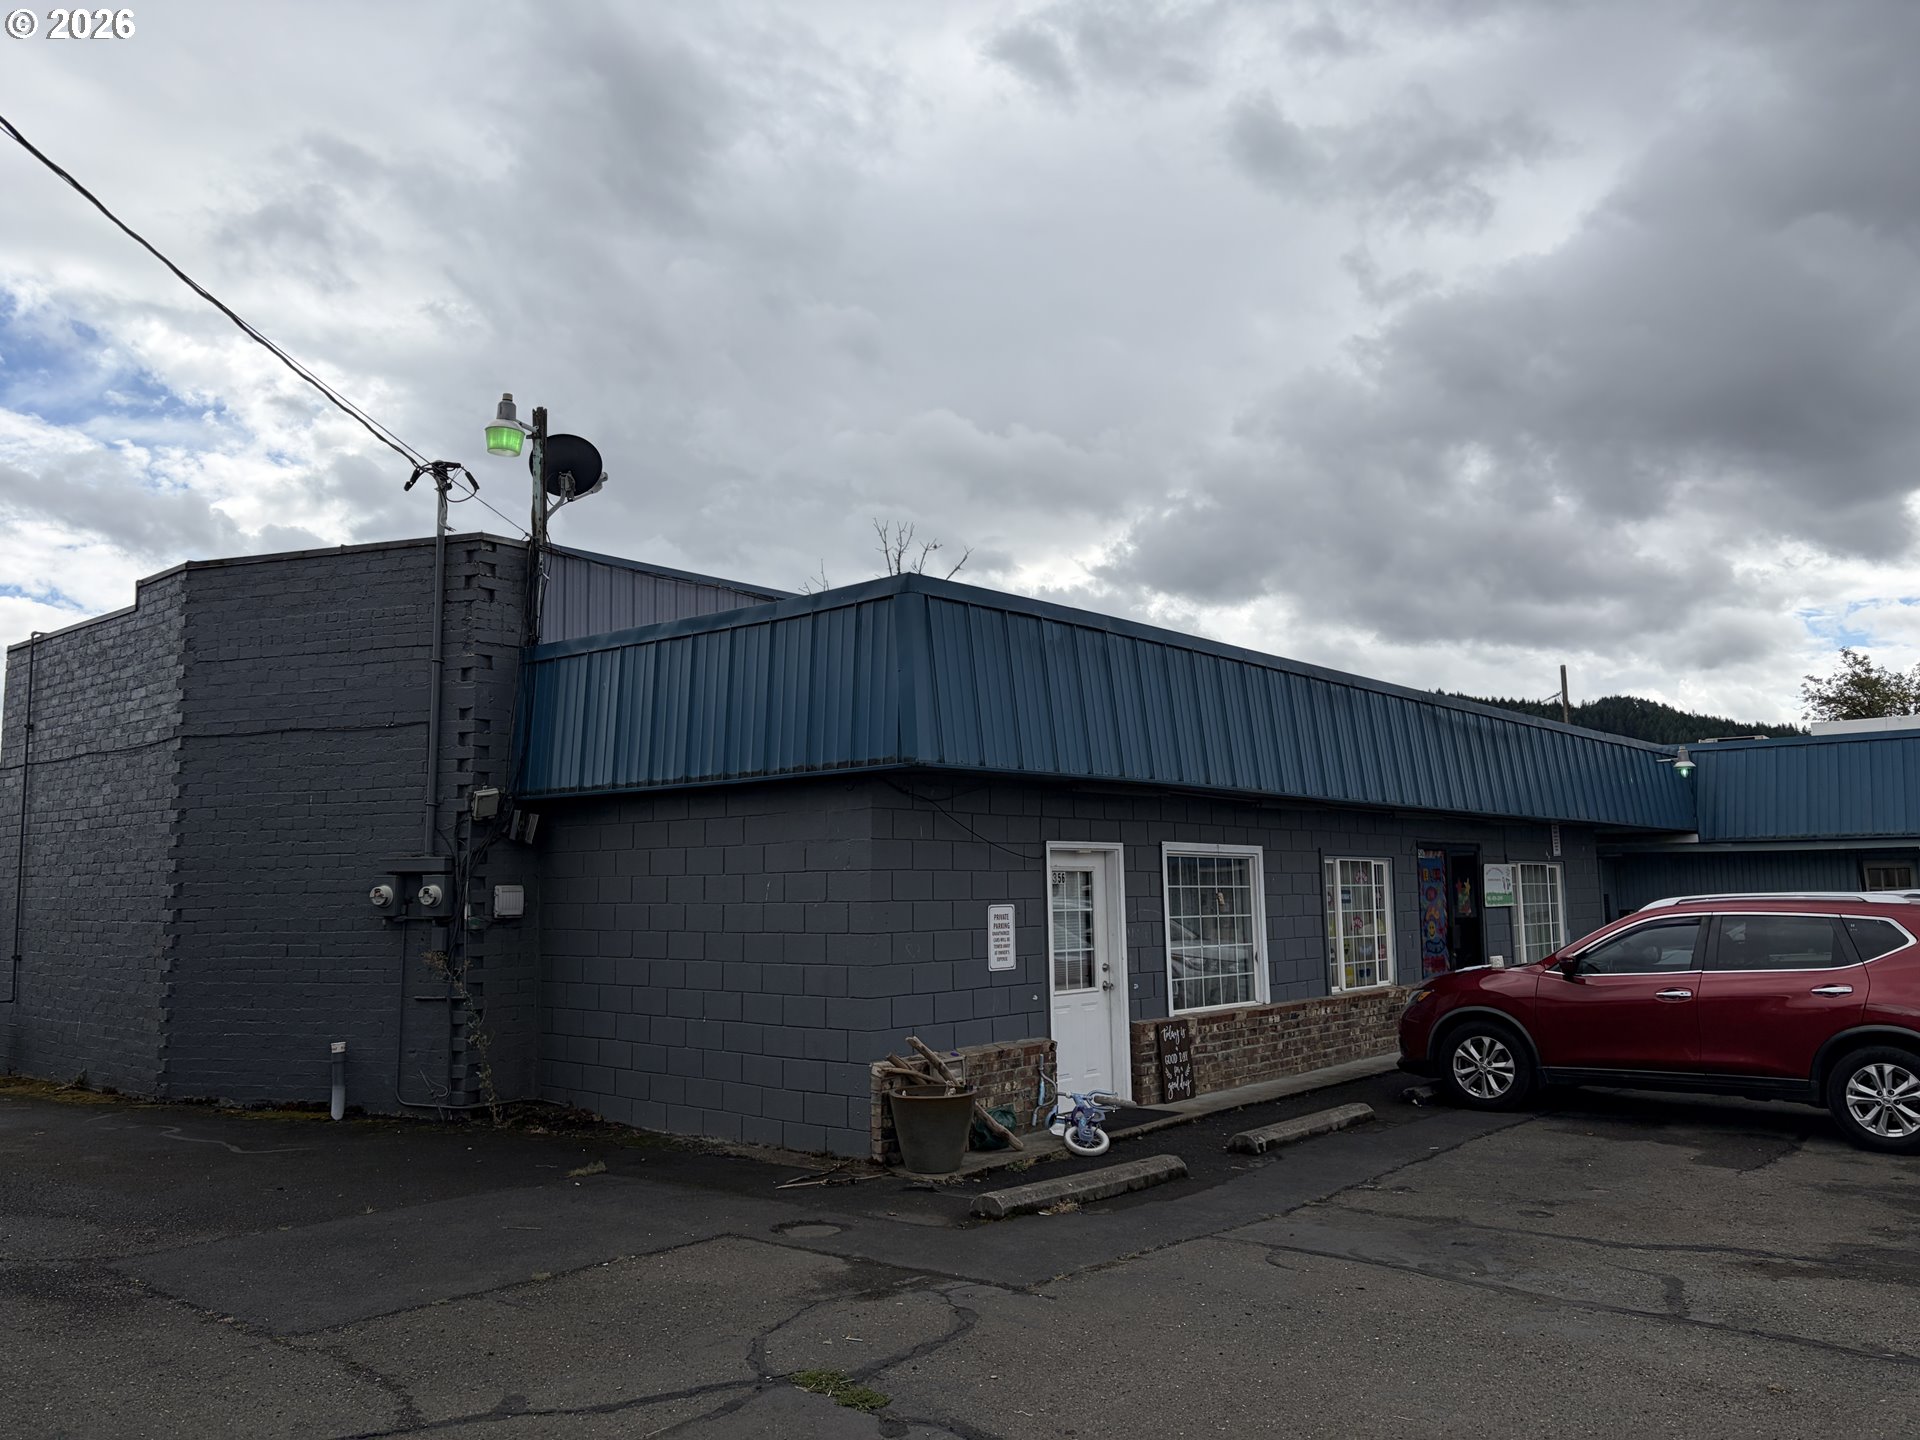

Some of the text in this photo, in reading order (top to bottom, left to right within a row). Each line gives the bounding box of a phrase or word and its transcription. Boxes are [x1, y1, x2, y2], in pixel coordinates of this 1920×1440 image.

[1052, 872, 1065, 883] 356
[1180, 1026, 1187, 1039] is
[1164, 1053, 1178, 1065] GOOD
[1179, 1073, 1192, 1097] day
